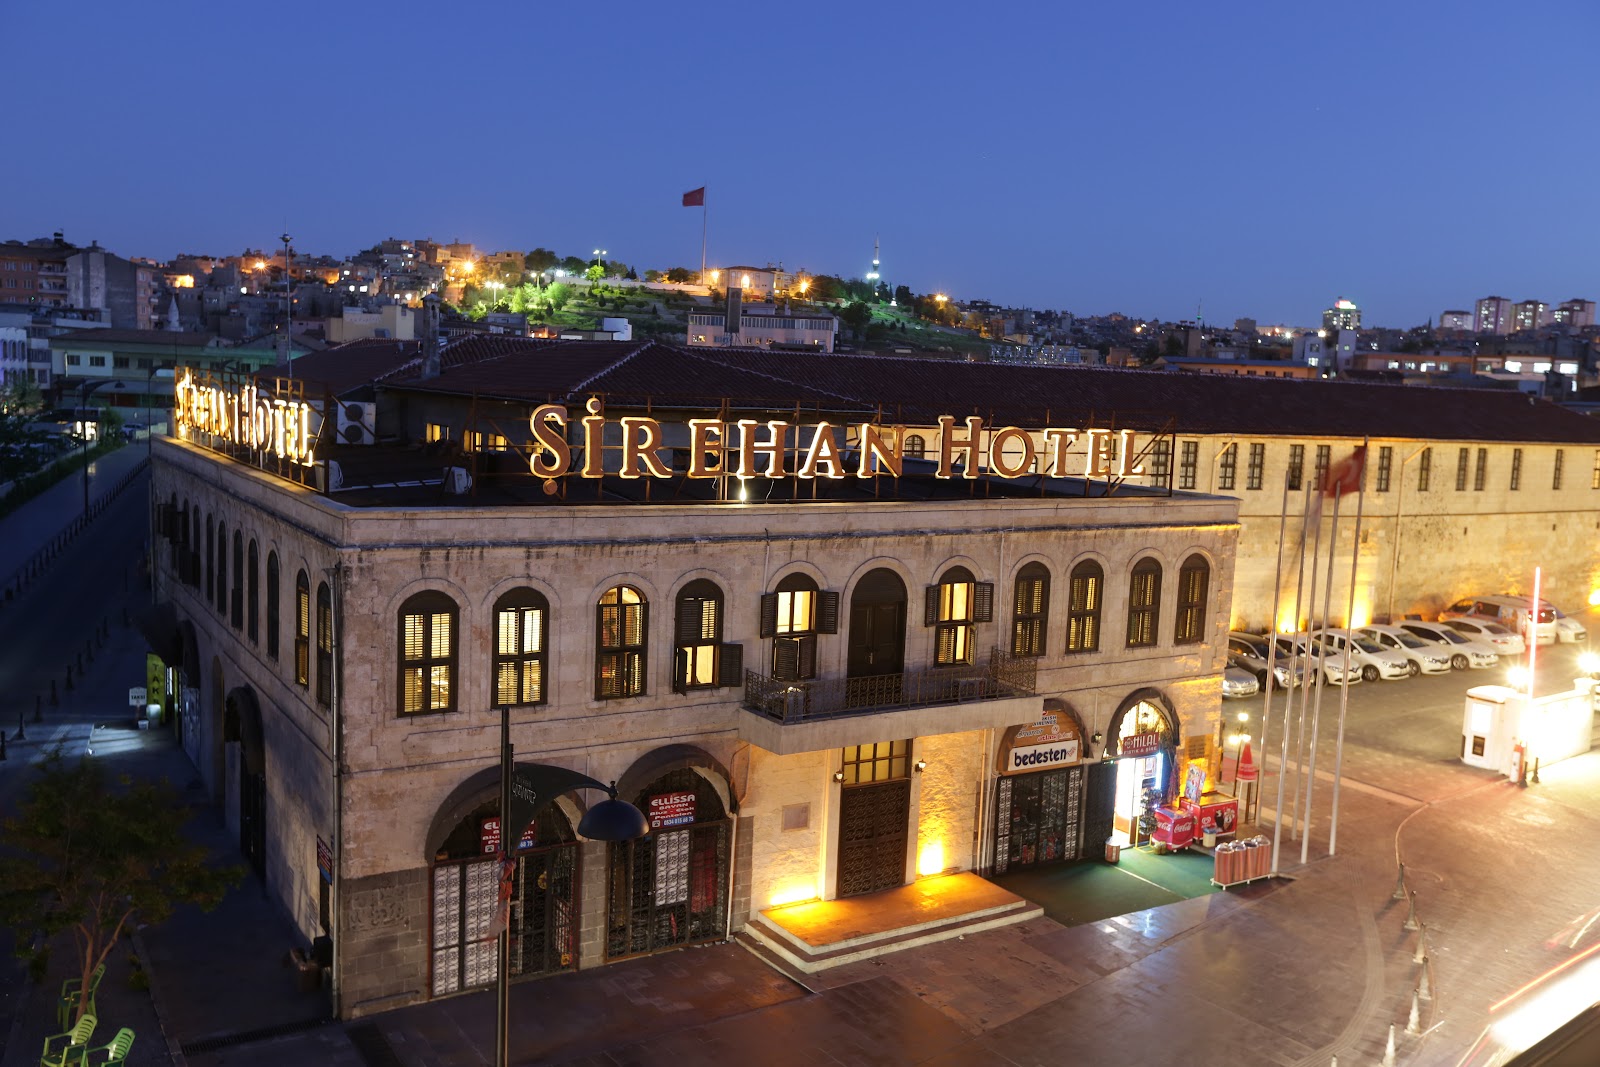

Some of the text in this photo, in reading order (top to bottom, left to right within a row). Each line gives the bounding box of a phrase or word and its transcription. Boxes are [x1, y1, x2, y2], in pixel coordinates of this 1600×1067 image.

[530, 397, 1147, 495] ŞİREHAN HOTEL
[1014, 748, 1067, 767] bedesten
[651, 794, 696, 806] ELLİSSA
